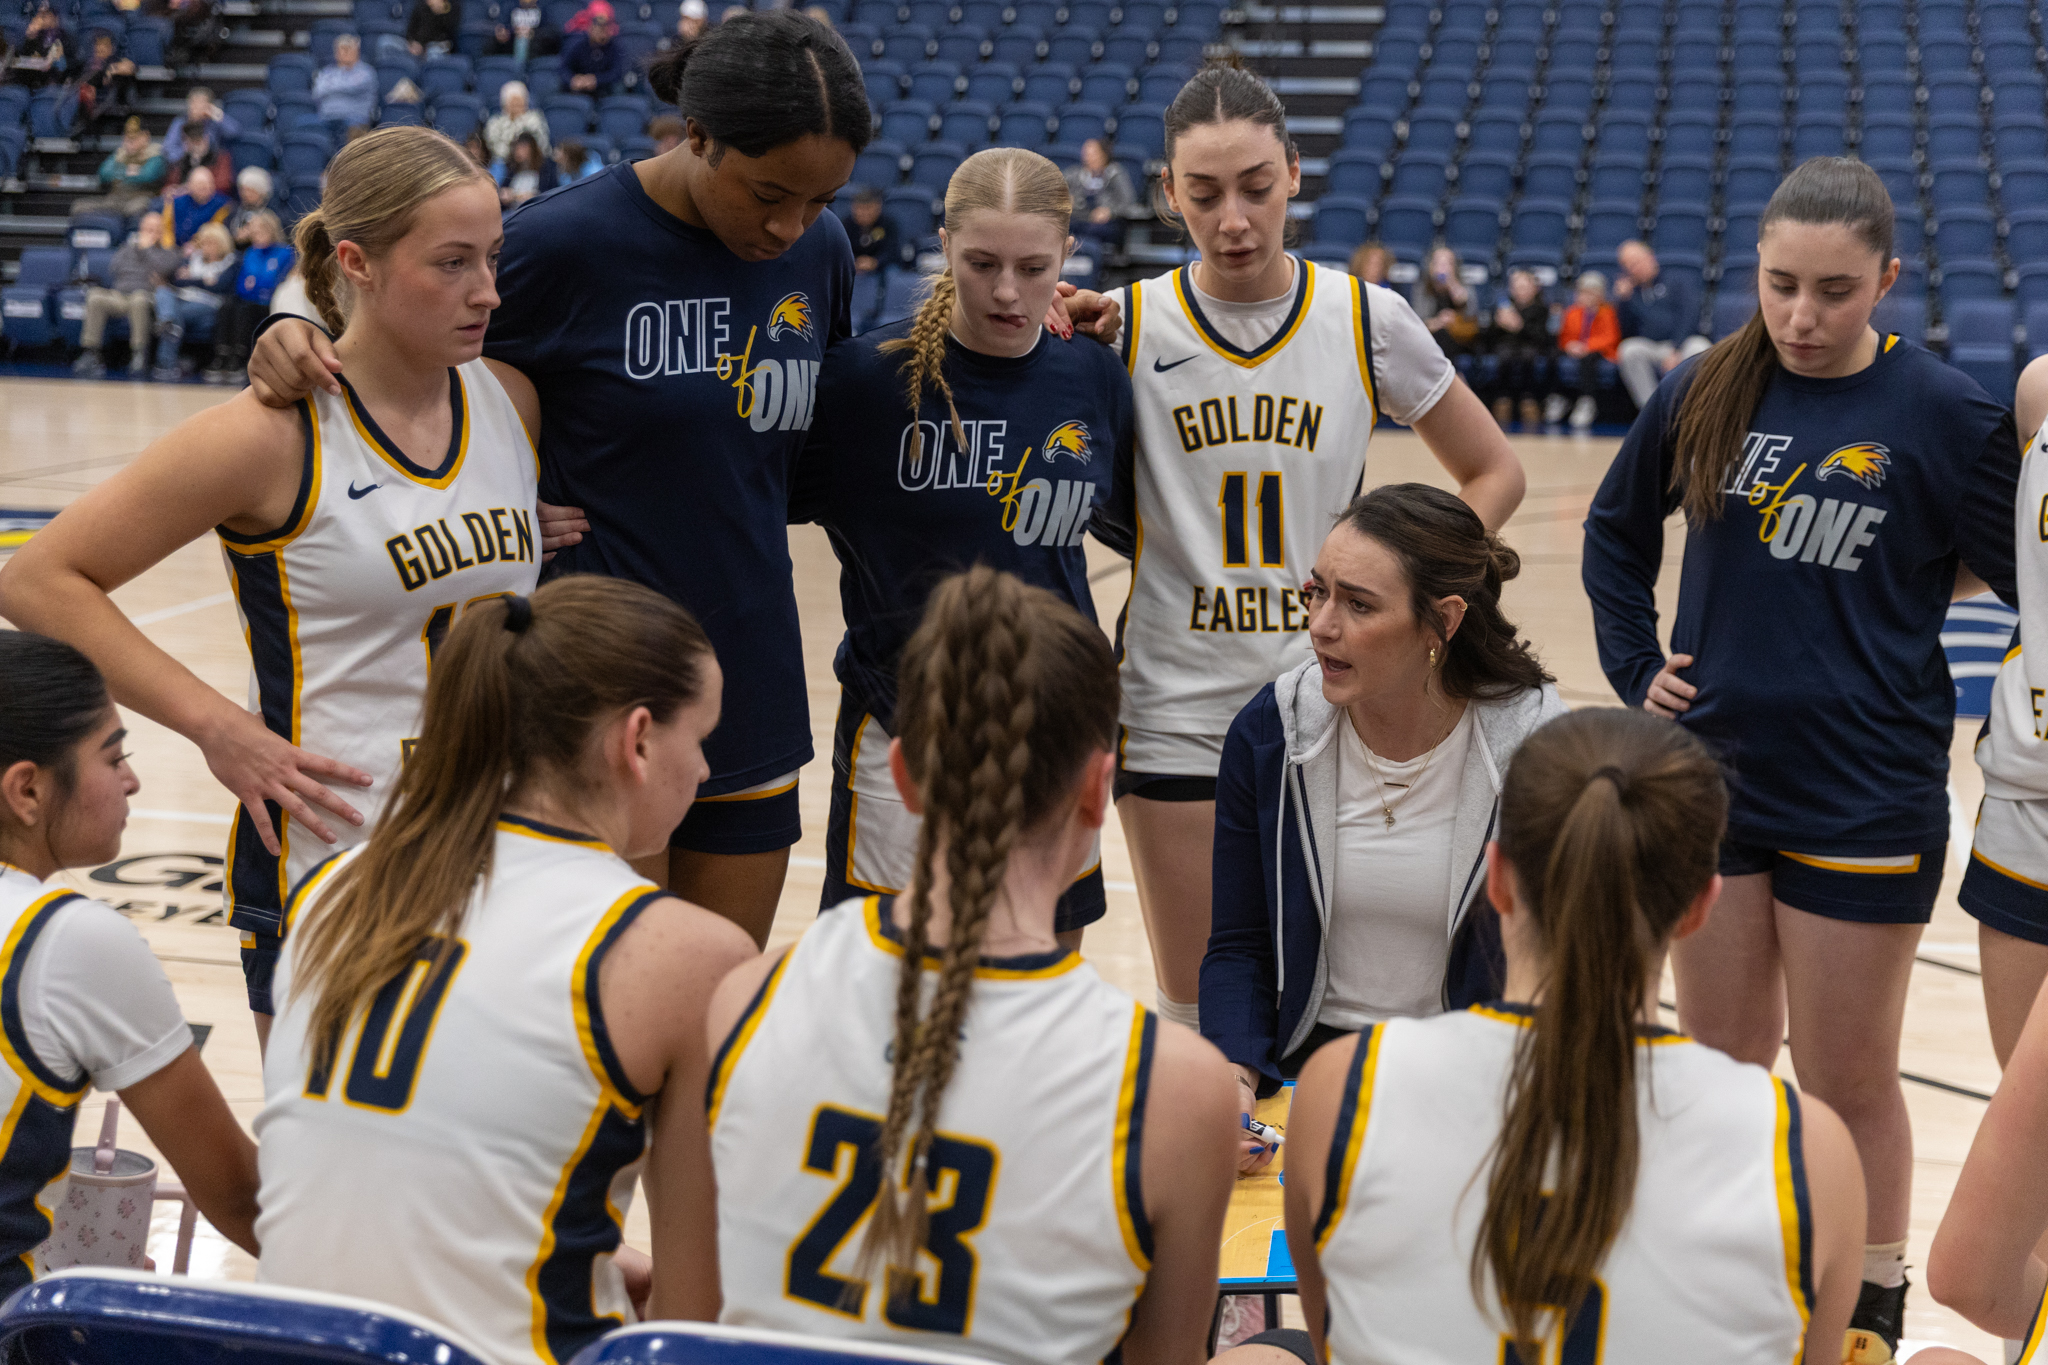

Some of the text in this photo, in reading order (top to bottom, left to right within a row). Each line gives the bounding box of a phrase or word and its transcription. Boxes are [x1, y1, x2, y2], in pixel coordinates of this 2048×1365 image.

[625, 298, 730, 379] ONE
[717, 325, 771, 418] of
[897, 420, 1007, 491] ONE
[1172, 394, 1324, 453] GOLDEN
[987, 446, 1040, 532] of
[1013, 478, 1096, 547] ONE
[1218, 471, 1285, 568] 11
[1748, 462, 1807, 542] of
[385, 507, 534, 592] GOLDEN
[1769, 494, 1887, 571] ONE
[782, 1101, 1002, 1338] 23
